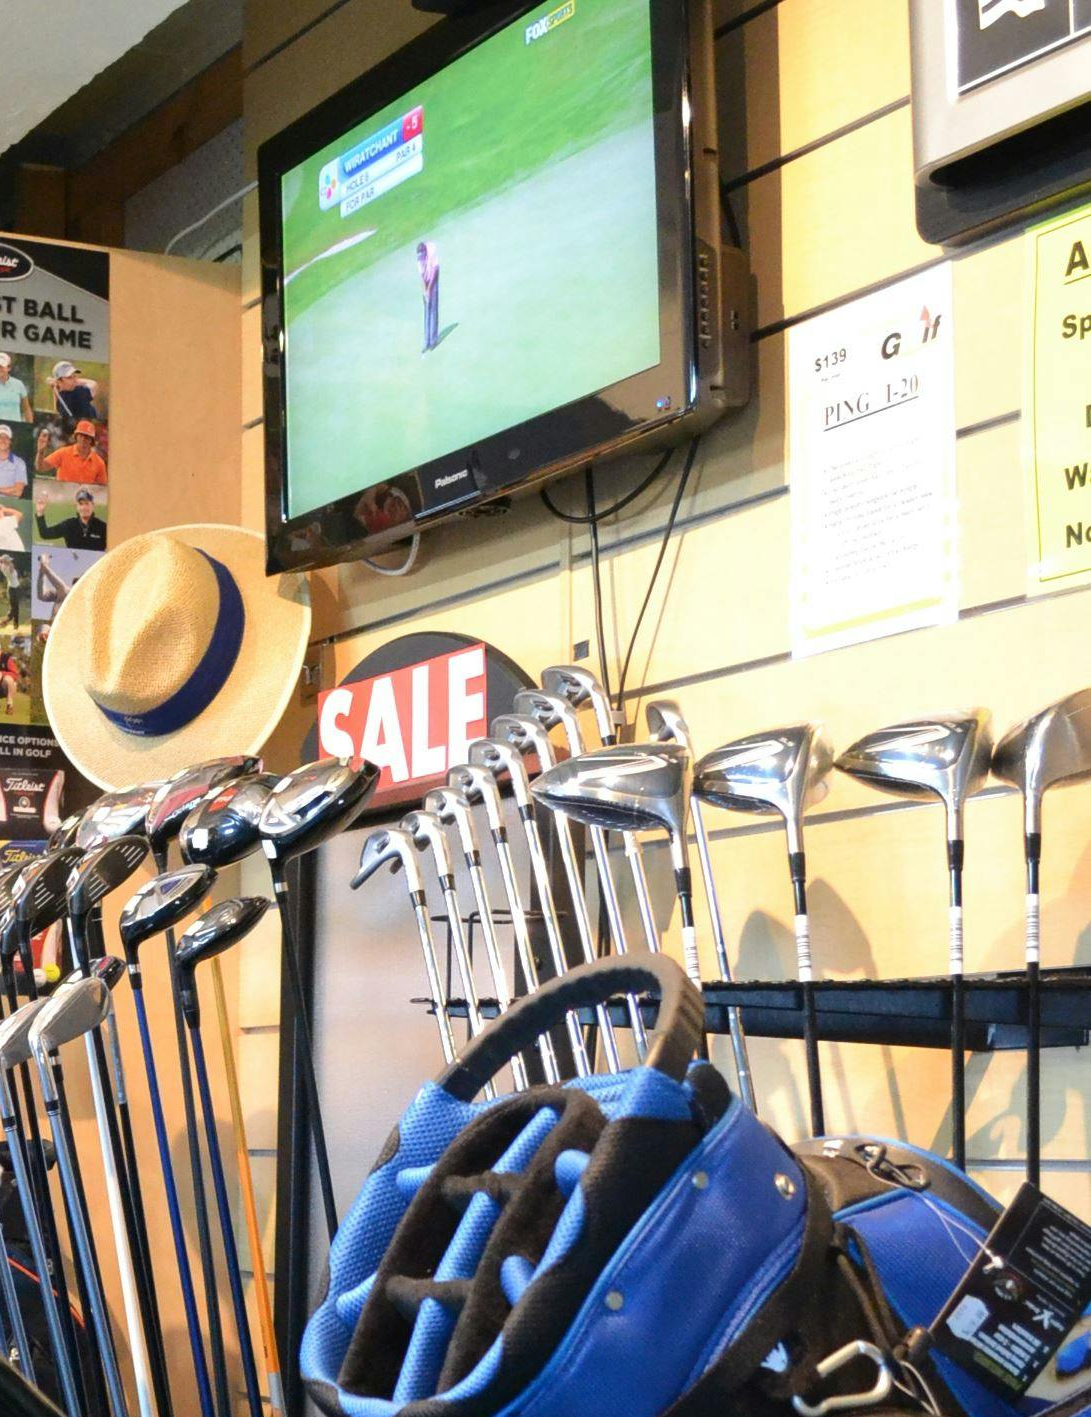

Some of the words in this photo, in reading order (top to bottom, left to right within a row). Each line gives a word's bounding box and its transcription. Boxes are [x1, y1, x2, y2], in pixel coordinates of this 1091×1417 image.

[526, 16, 549, 45] FOX
[344, 129, 398, 173] WIRATCHANT
[361, 187, 375, 201] PAR
[23, 299, 84, 323] BALL
[23, 324, 93, 349] GAME
[814, 347, 847, 373] $139
[823, 393, 870, 427] PING
[1064, 462, 1091, 491] W
[319, 648, 486, 783] SALE
[13, 748, 24, 757] IN
[25, 749, 52, 758] GOLF
[3, 777, 46, 792] Titleist
